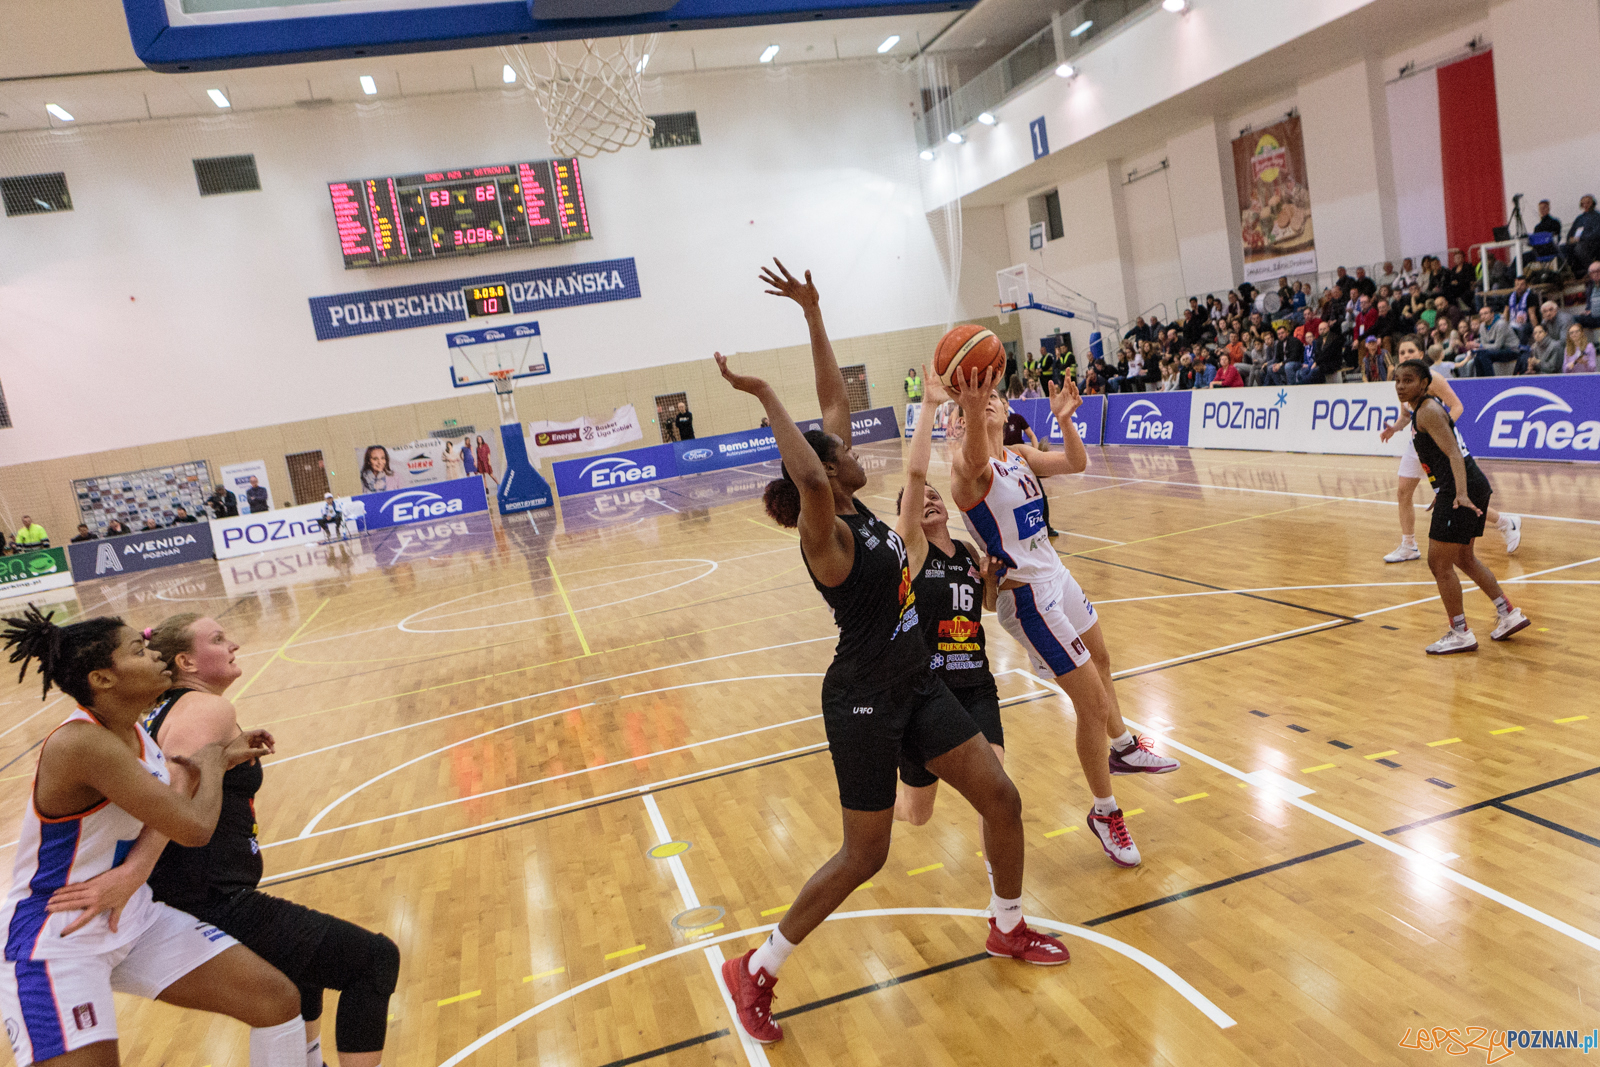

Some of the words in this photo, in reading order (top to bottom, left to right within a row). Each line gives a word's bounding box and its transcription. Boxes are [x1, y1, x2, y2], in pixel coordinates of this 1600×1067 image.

[1033, 122, 1044, 156] 1
[429, 189, 450, 207] 53
[475, 184, 496, 202] 62
[483, 298, 498, 314] 10
[850, 417, 882, 430] NIDA
[1125, 414, 1174, 440] Enea
[1311, 398, 1403, 432] POZna
[551, 432, 577, 442] Energa
[851, 428, 871, 437] ZNAŃ
[1488, 410, 1600, 451] Enea
[718, 441, 749, 454] Bemo
[748, 436, 777, 448] Moto
[591, 463, 657, 489] Enea
[1017, 474, 1041, 501] 11
[392, 498, 463, 523] Enea
[123, 533, 197, 556] AVENIDA
[222, 517, 323, 549] POZna
[142, 546, 181, 561] POZNAŃ
[949, 582, 974, 612] 16
